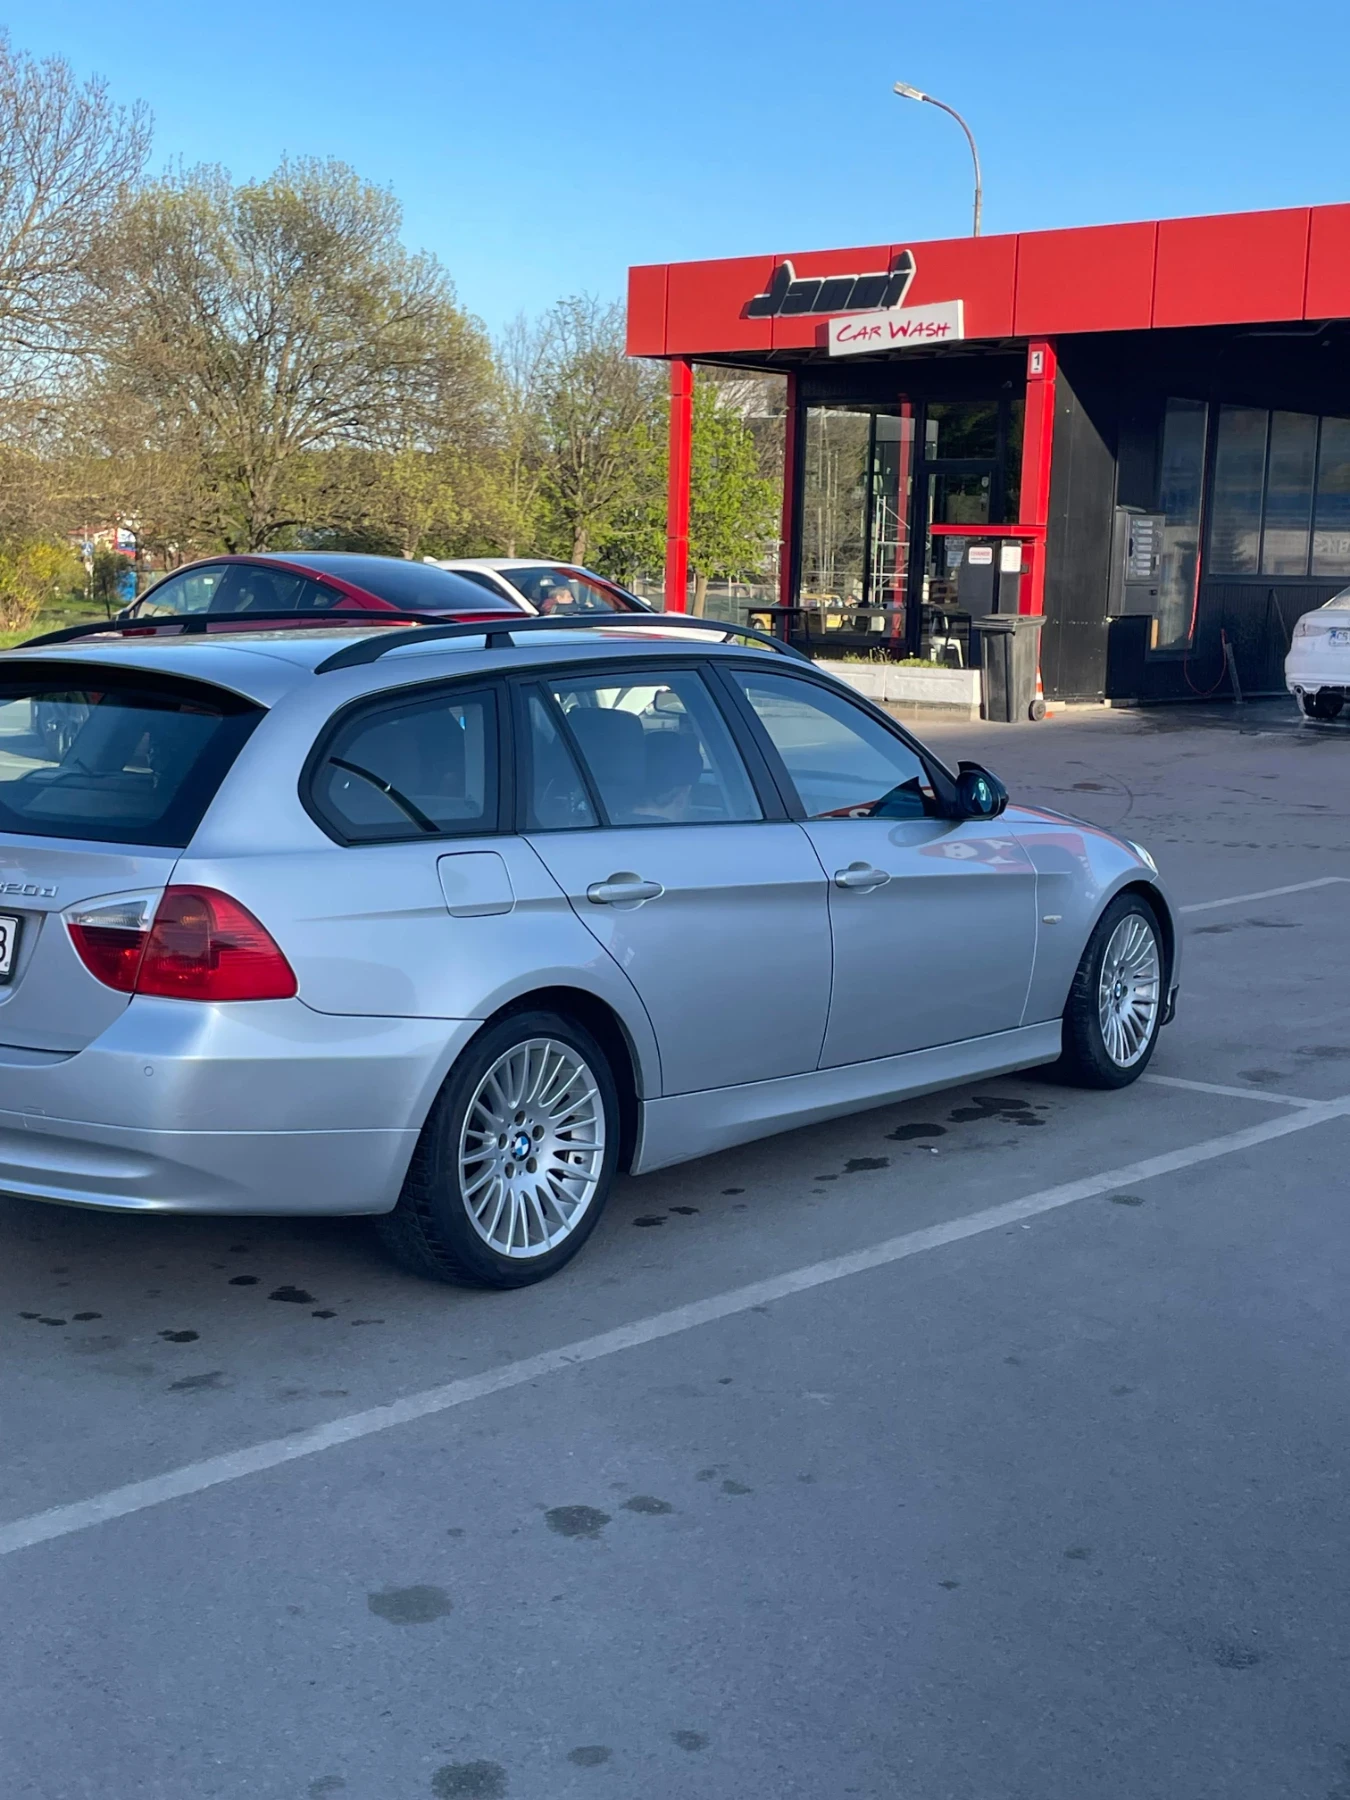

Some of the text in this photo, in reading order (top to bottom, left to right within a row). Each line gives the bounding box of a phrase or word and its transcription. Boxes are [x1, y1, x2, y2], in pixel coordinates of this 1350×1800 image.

[836, 320, 952, 343] CAR WASH
[0, 882, 59, 898] 20d
